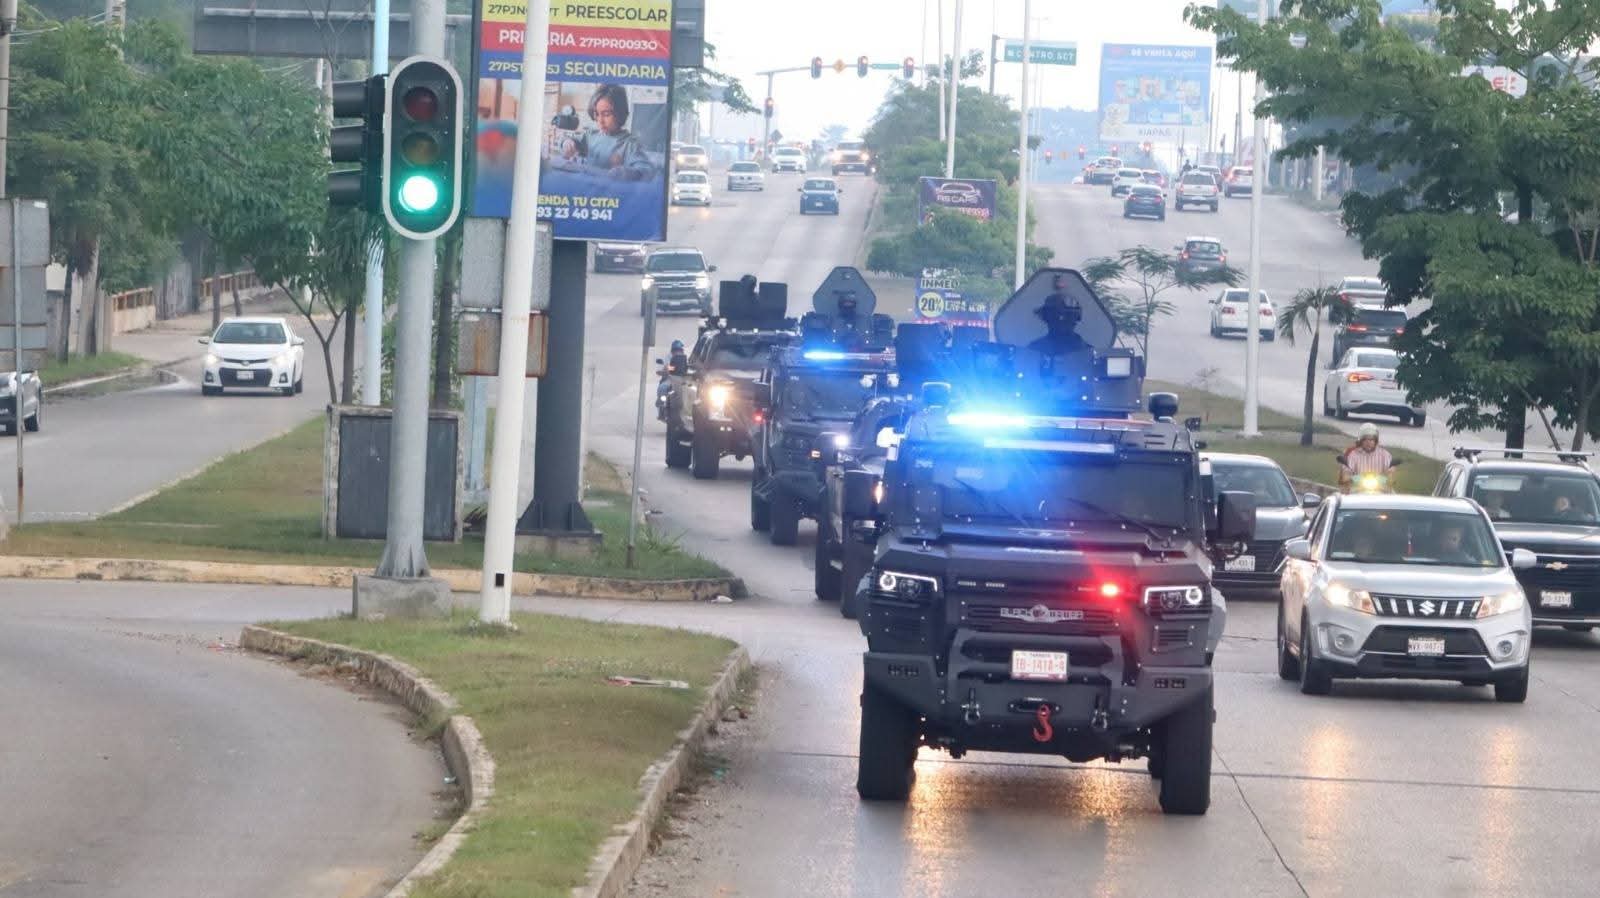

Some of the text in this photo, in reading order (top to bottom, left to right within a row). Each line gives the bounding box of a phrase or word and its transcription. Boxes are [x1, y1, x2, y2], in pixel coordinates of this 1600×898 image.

[488, 4, 668, 21] 27PJNT PREESCOLAR
[499, 29, 576, 46] PRIRIA
[564, 61, 666, 79] SECUNDARIA
[538, 194, 570, 206] ENDA
[572, 196, 587, 206] TU
[537, 206, 613, 220] 93 23 40 941
[921, 279, 960, 289] INMED
